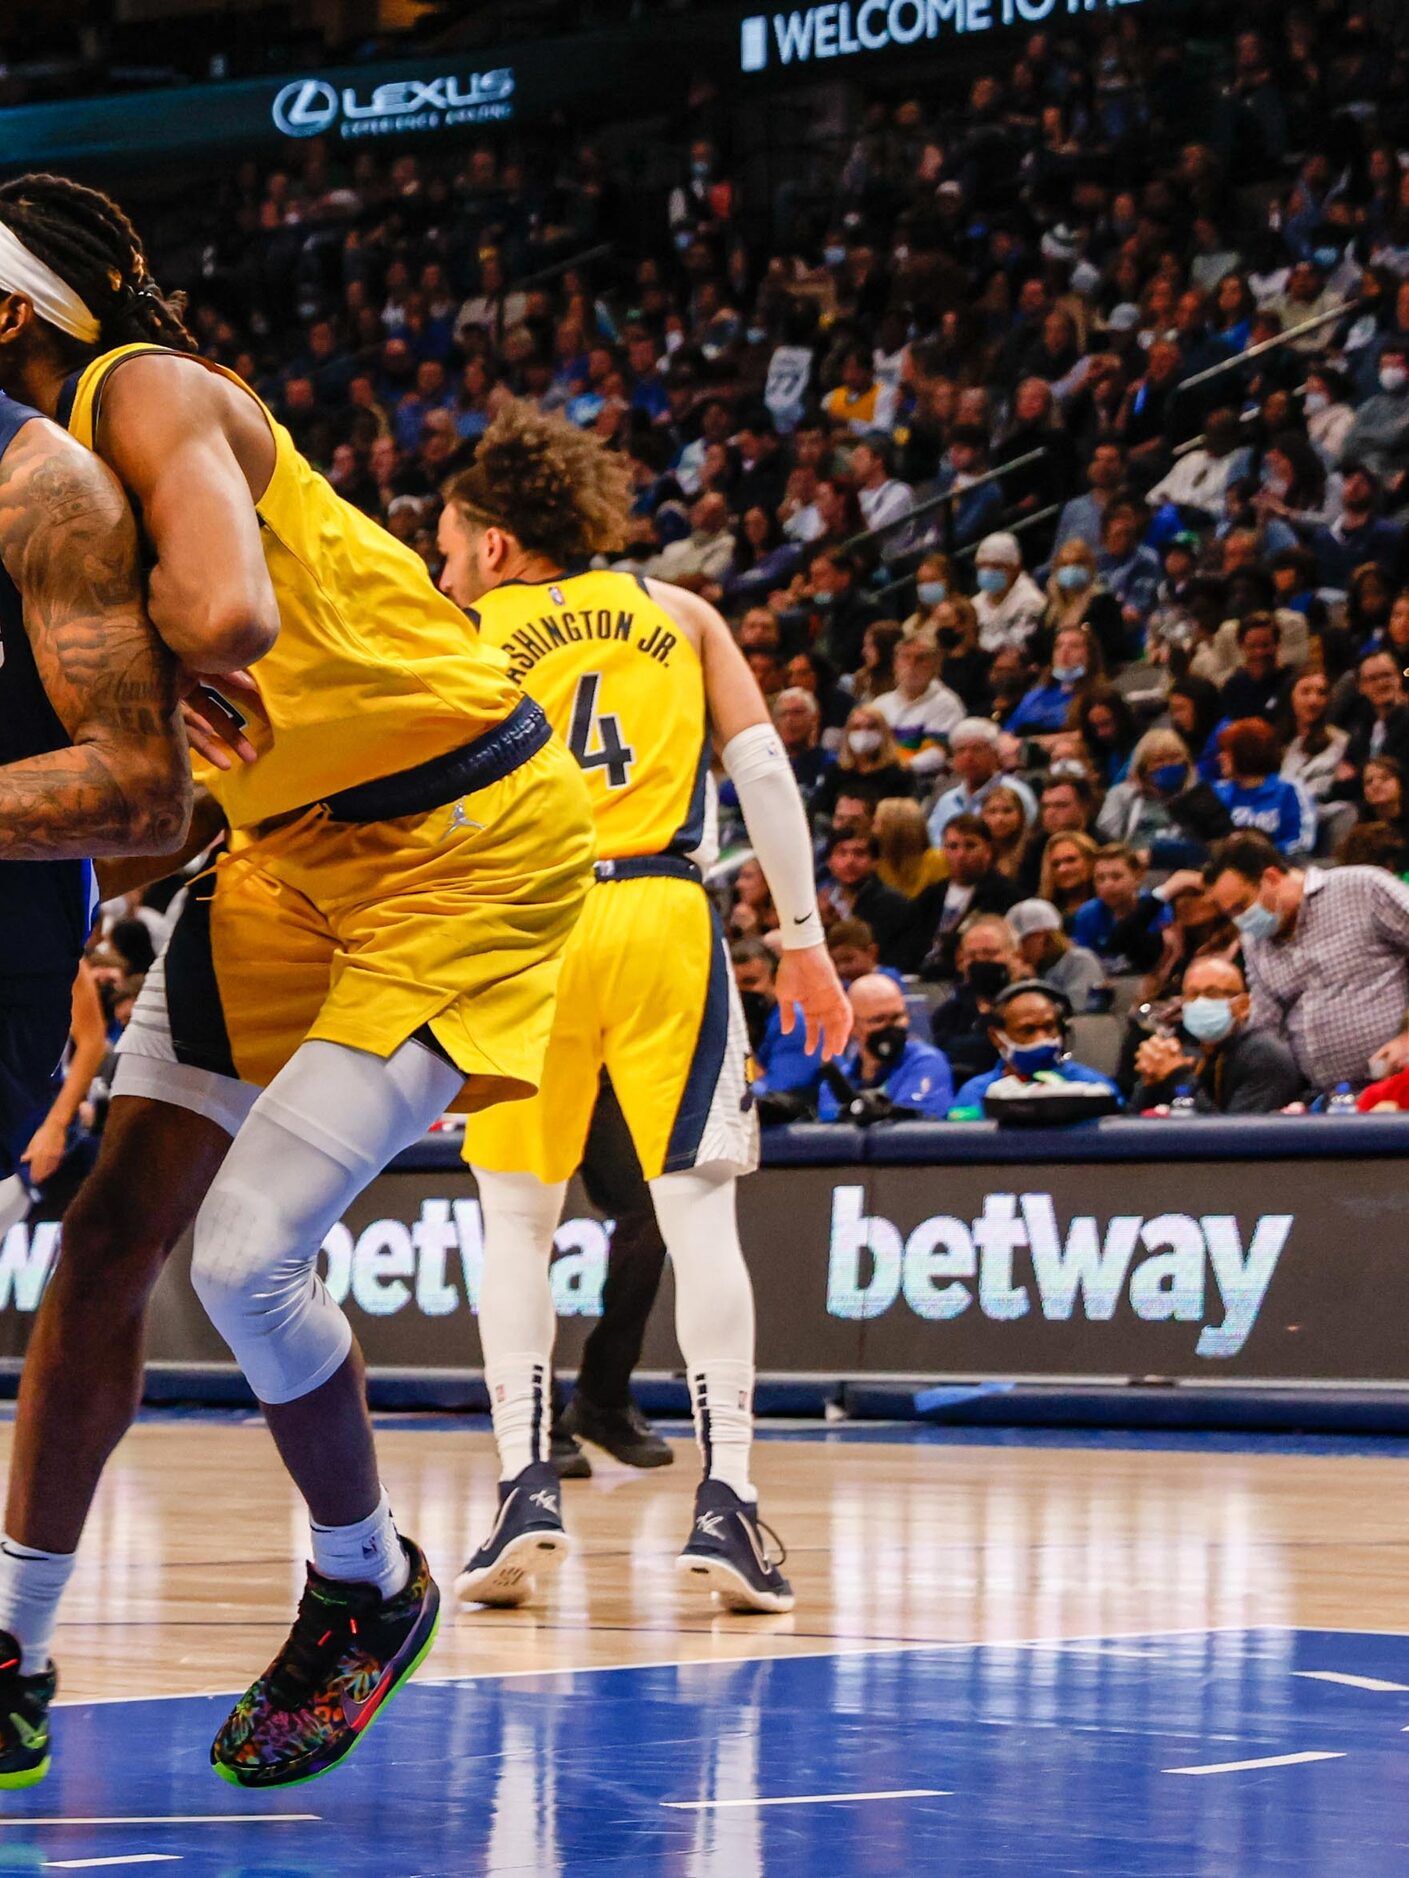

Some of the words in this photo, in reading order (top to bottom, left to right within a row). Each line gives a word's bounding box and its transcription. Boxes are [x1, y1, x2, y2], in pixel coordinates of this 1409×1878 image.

[773, 0, 992, 65] WELCOME
[342, 67, 515, 119] LEXUS
[501, 609, 634, 685] ASHINGTON
[637, 625, 677, 668] JR.
[567, 672, 634, 788] 4
[826, 1185, 1294, 1359] betway
